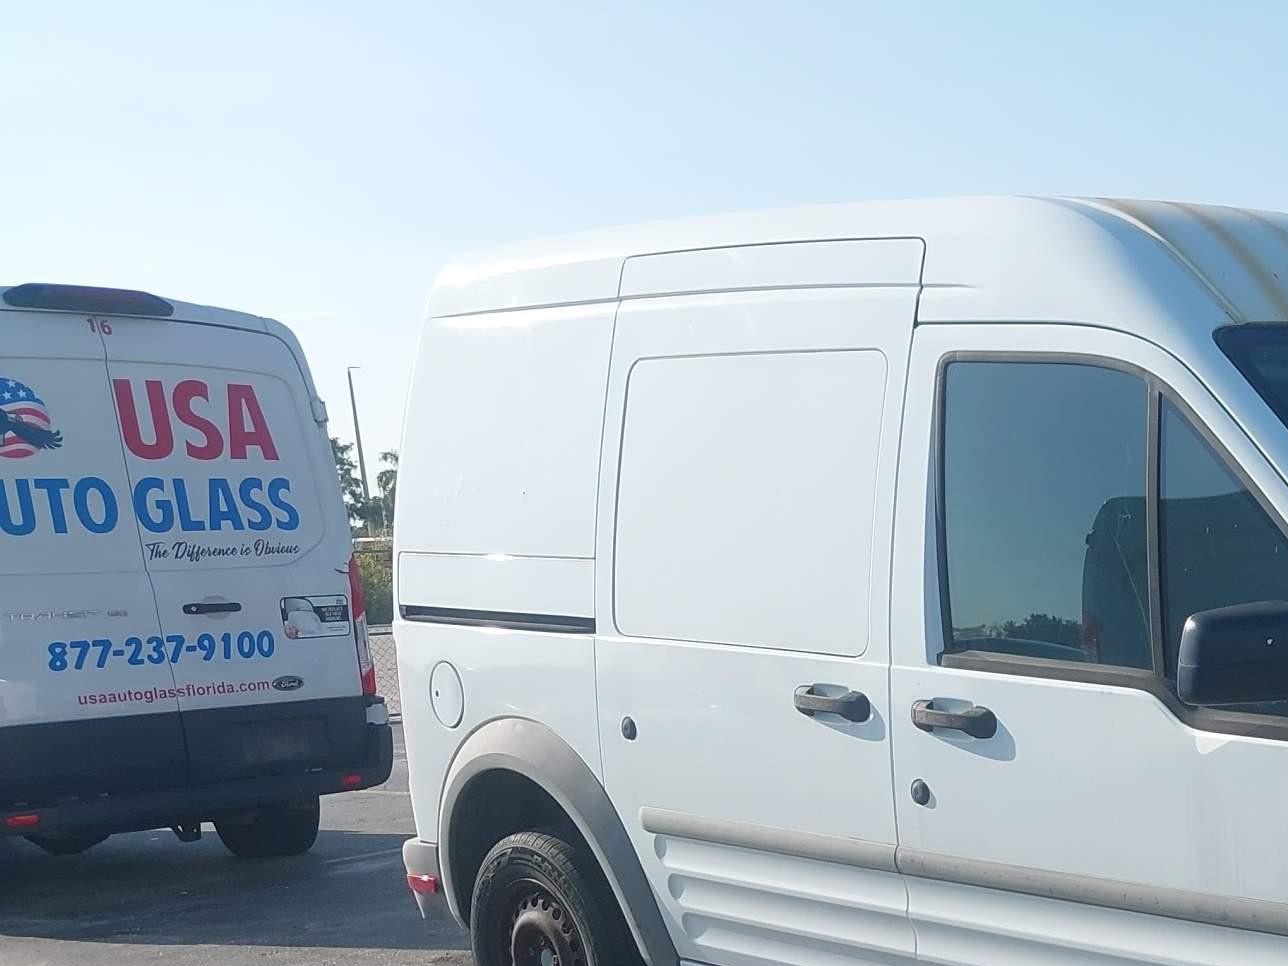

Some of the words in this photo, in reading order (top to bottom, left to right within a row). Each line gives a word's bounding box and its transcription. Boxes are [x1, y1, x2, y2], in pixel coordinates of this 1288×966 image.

[86, 317, 113, 336] 16
[112, 378, 280, 461] USA
[0, 476, 119, 536] UTO
[133, 476, 300, 532] GLASS
[145, 541, 169, 561] The
[171, 541, 238, 562] Difference
[240, 543, 251, 556] is
[253, 538, 300, 557] Obvious
[47, 630, 275, 672] 877-237-9100
[77, 679, 271, 706] usaautoglassflorida.com
